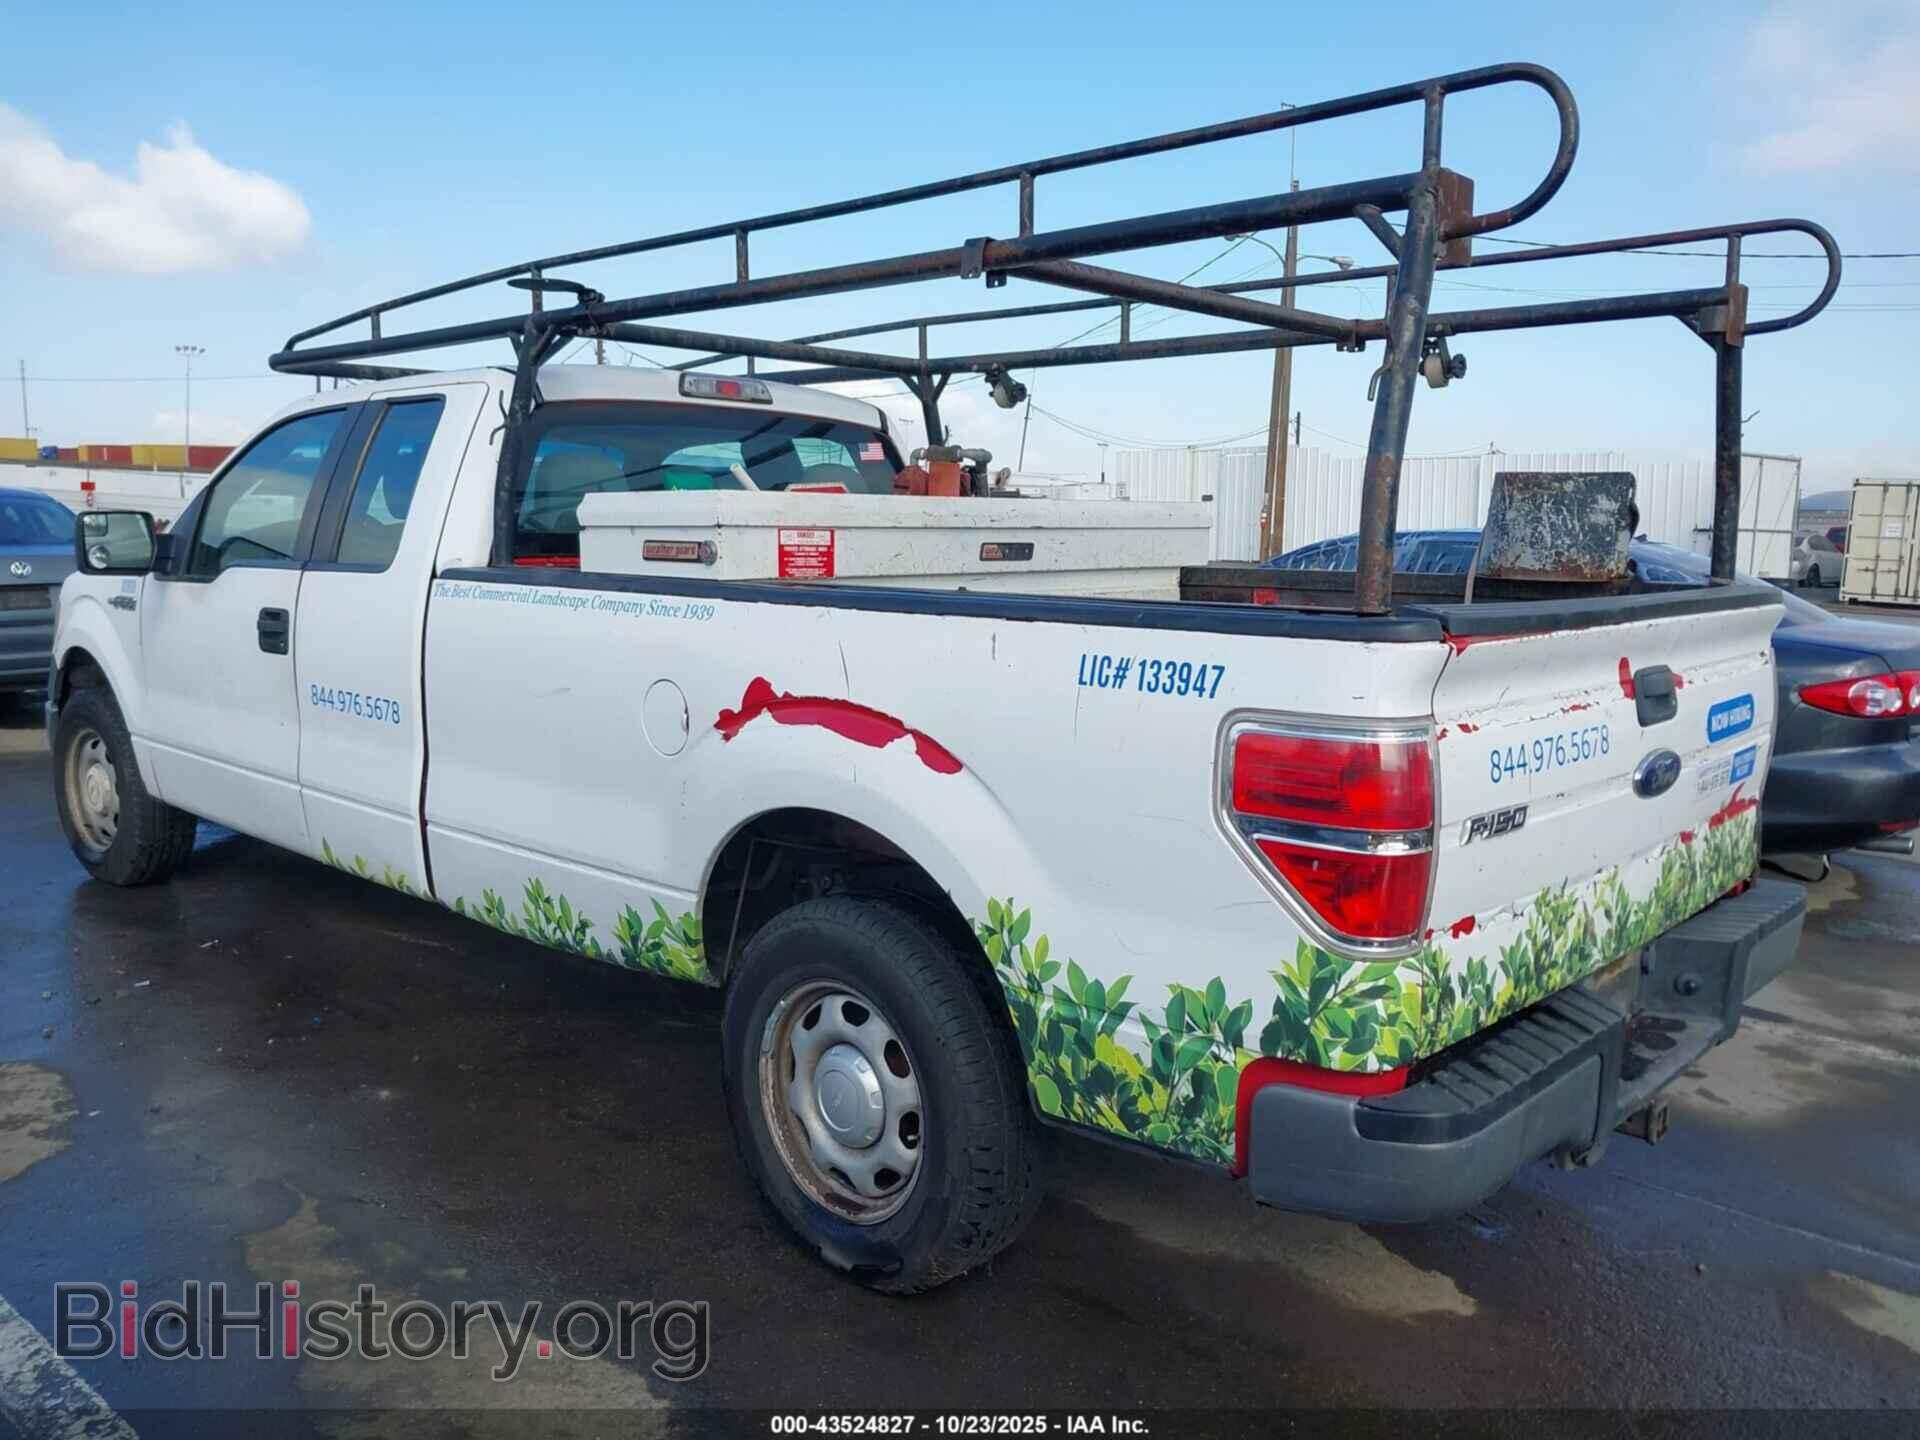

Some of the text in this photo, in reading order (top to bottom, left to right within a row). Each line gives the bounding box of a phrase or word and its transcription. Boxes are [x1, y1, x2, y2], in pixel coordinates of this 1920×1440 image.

[434, 583, 716, 621] The Best Commercial Landscape Company Since 1939
[1078, 653, 1226, 699] LIC# 133947
[311, 684, 401, 725] 844.976.5678
[1490, 724, 1610, 783] 844.976.5678
